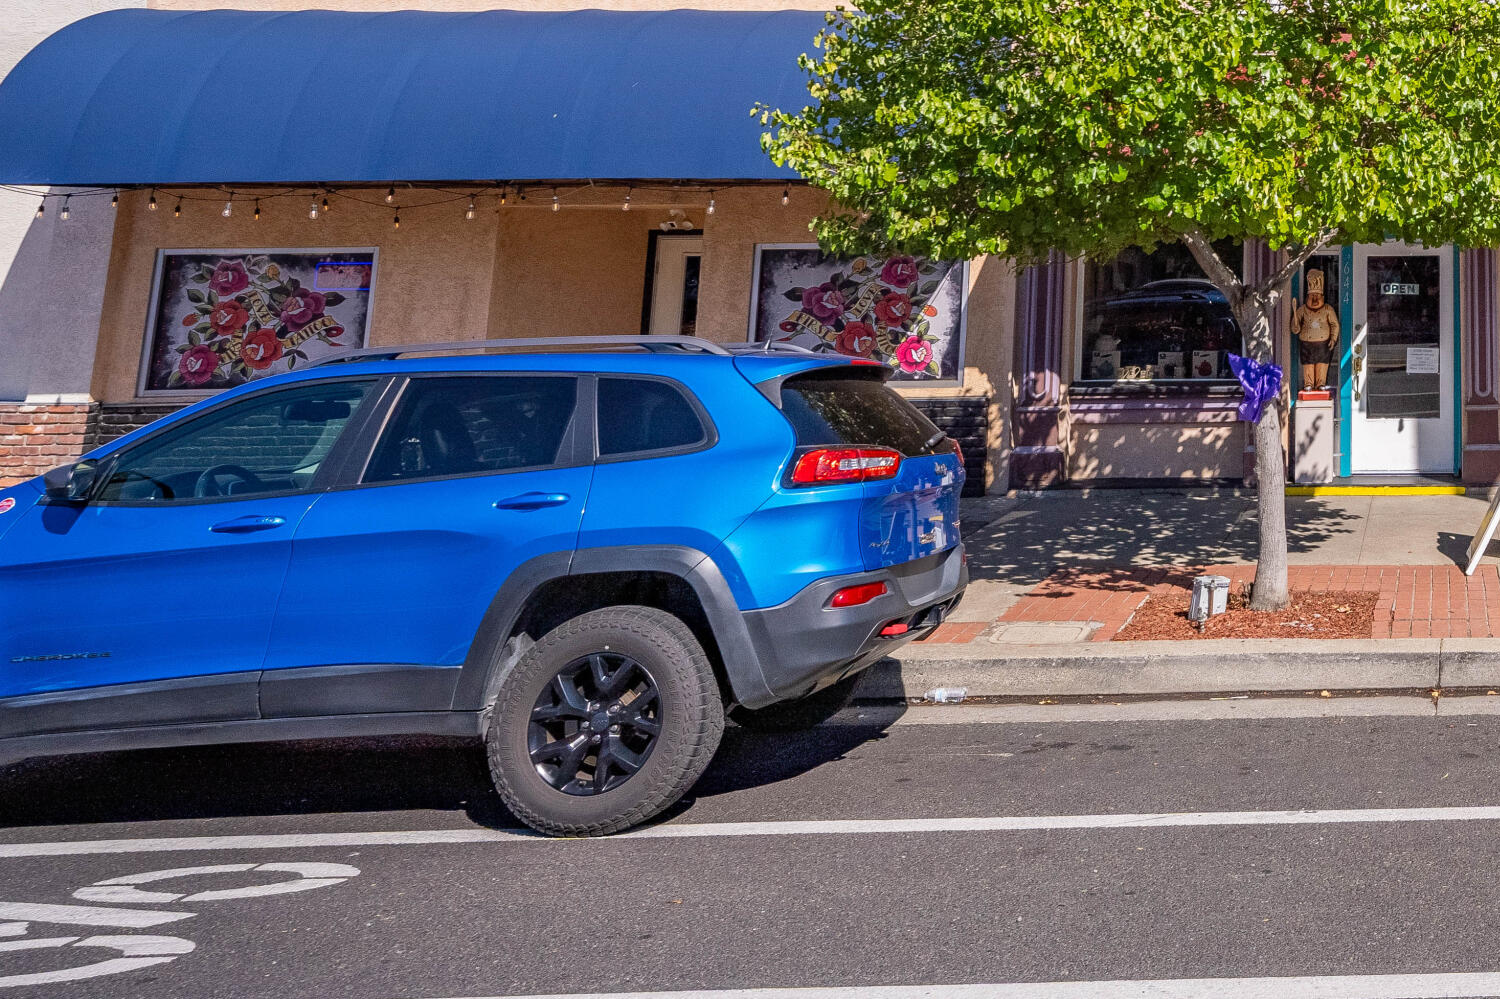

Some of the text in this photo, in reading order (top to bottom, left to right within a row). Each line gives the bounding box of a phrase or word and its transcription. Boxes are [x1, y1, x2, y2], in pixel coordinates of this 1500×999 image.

[855, 285, 876, 314] LOVE
[1382, 284, 1416, 294] OPEN
[248, 290, 272, 320] LOVE
[289, 317, 332, 346] TATTOO
[796, 312, 830, 340] FIRST
